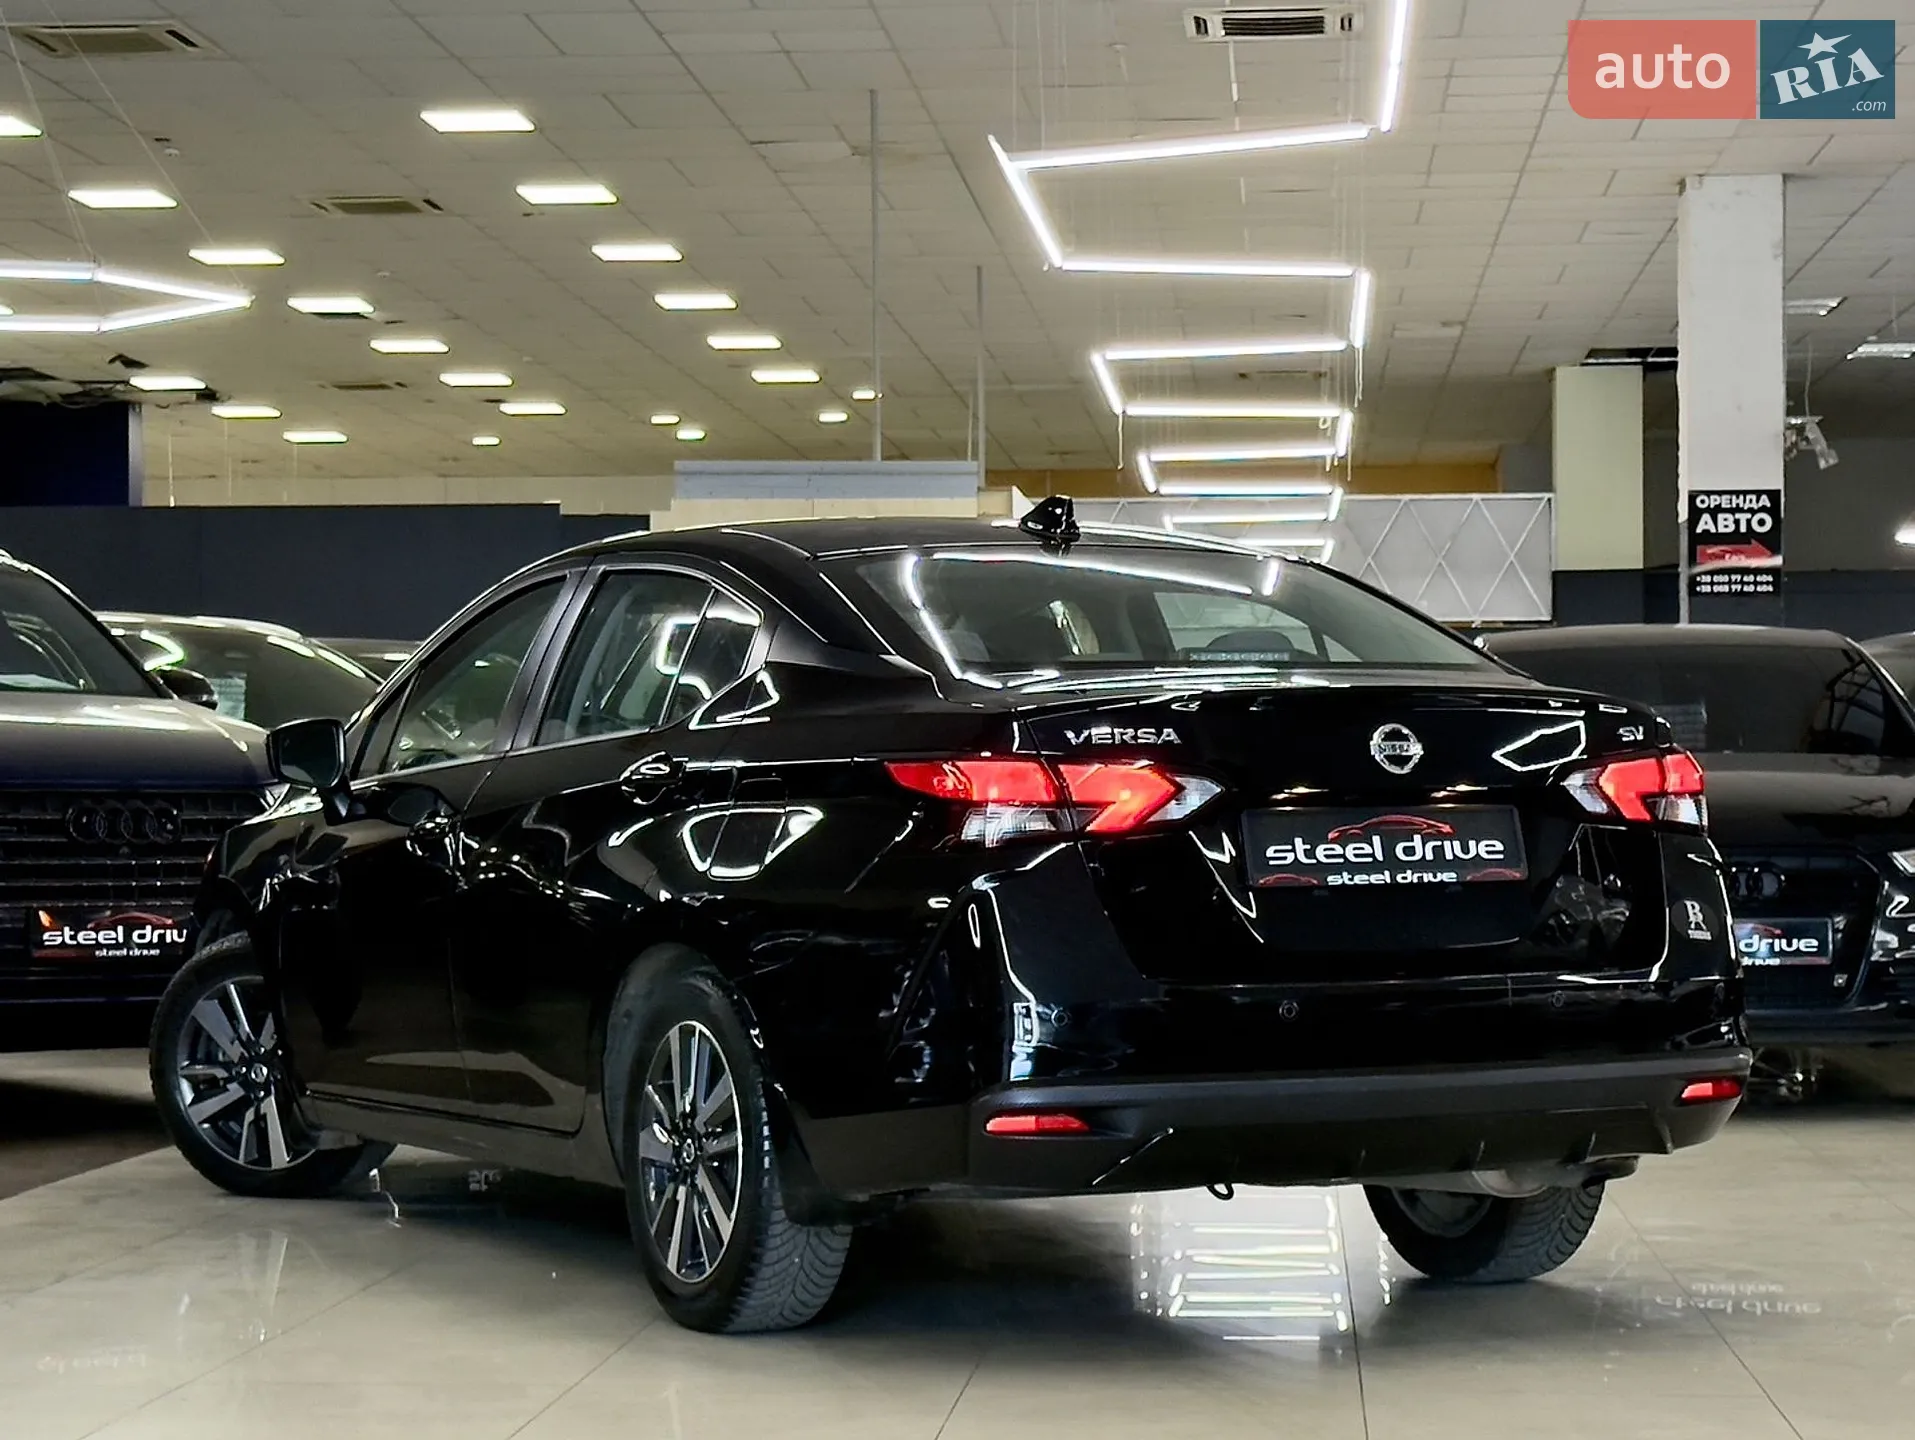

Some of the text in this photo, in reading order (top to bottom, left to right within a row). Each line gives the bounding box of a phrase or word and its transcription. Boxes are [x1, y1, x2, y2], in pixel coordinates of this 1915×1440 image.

[1695, 494, 1771, 510] ОРЕНДА
[1695, 512, 1773, 533] АВТО
[1063, 726, 1182, 746] VERSA
[1265, 833, 1504, 865] steel drive
[1326, 870, 1457, 886] steel drive
[42, 925, 187, 946] steel driv
[1739, 934, 1819, 952] drive
[95, 948, 160, 957] steel drive
